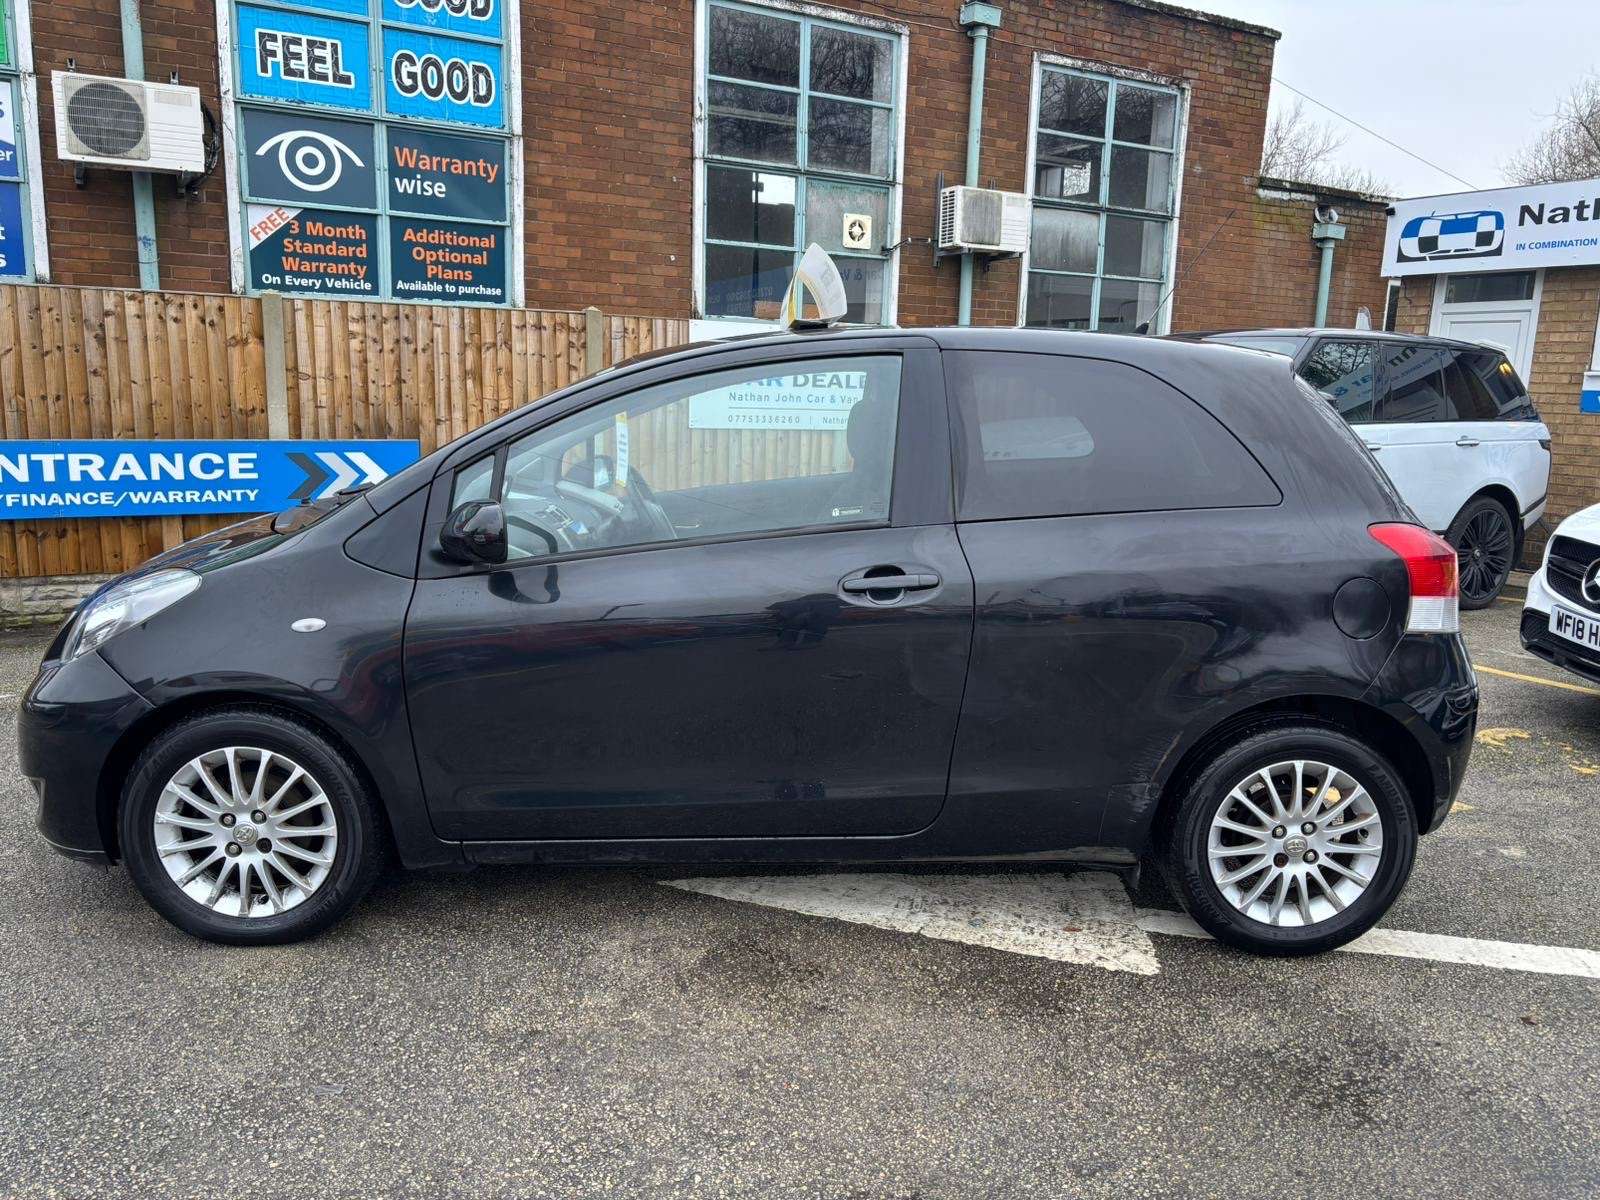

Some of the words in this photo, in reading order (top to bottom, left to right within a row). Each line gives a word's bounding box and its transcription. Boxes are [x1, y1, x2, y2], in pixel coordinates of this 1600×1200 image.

[256, 29, 354, 87] FEEL
[393, 51, 494, 106] GOOD
[394, 146, 499, 183] Warranty
[394, 174, 446, 198] wise
[249, 207, 290, 241] FREE
[289, 219, 300, 234] 3
[306, 221, 367, 240] Month
[283, 238, 367, 258] Standard
[403, 228, 496, 249] Additional
[1515, 242, 1526, 251] IN
[1528, 238, 1598, 250] COMBINATION
[412, 246, 488, 265] Optional
[281, 256, 367, 279] Warranty
[426, 264, 474, 281] Plans
[261, 273, 280, 285] On
[285, 275, 321, 289] Every
[326, 278, 372, 290] Vehicle
[396, 280, 443, 292] Available
[445, 284, 456, 293] to
[458, 285, 502, 297] purchase
[728, 391, 770, 402] Nathan
[775, 393, 802, 403] John
[806, 394, 825, 403] Car
[1556, 610, 1585, 641] WF18
